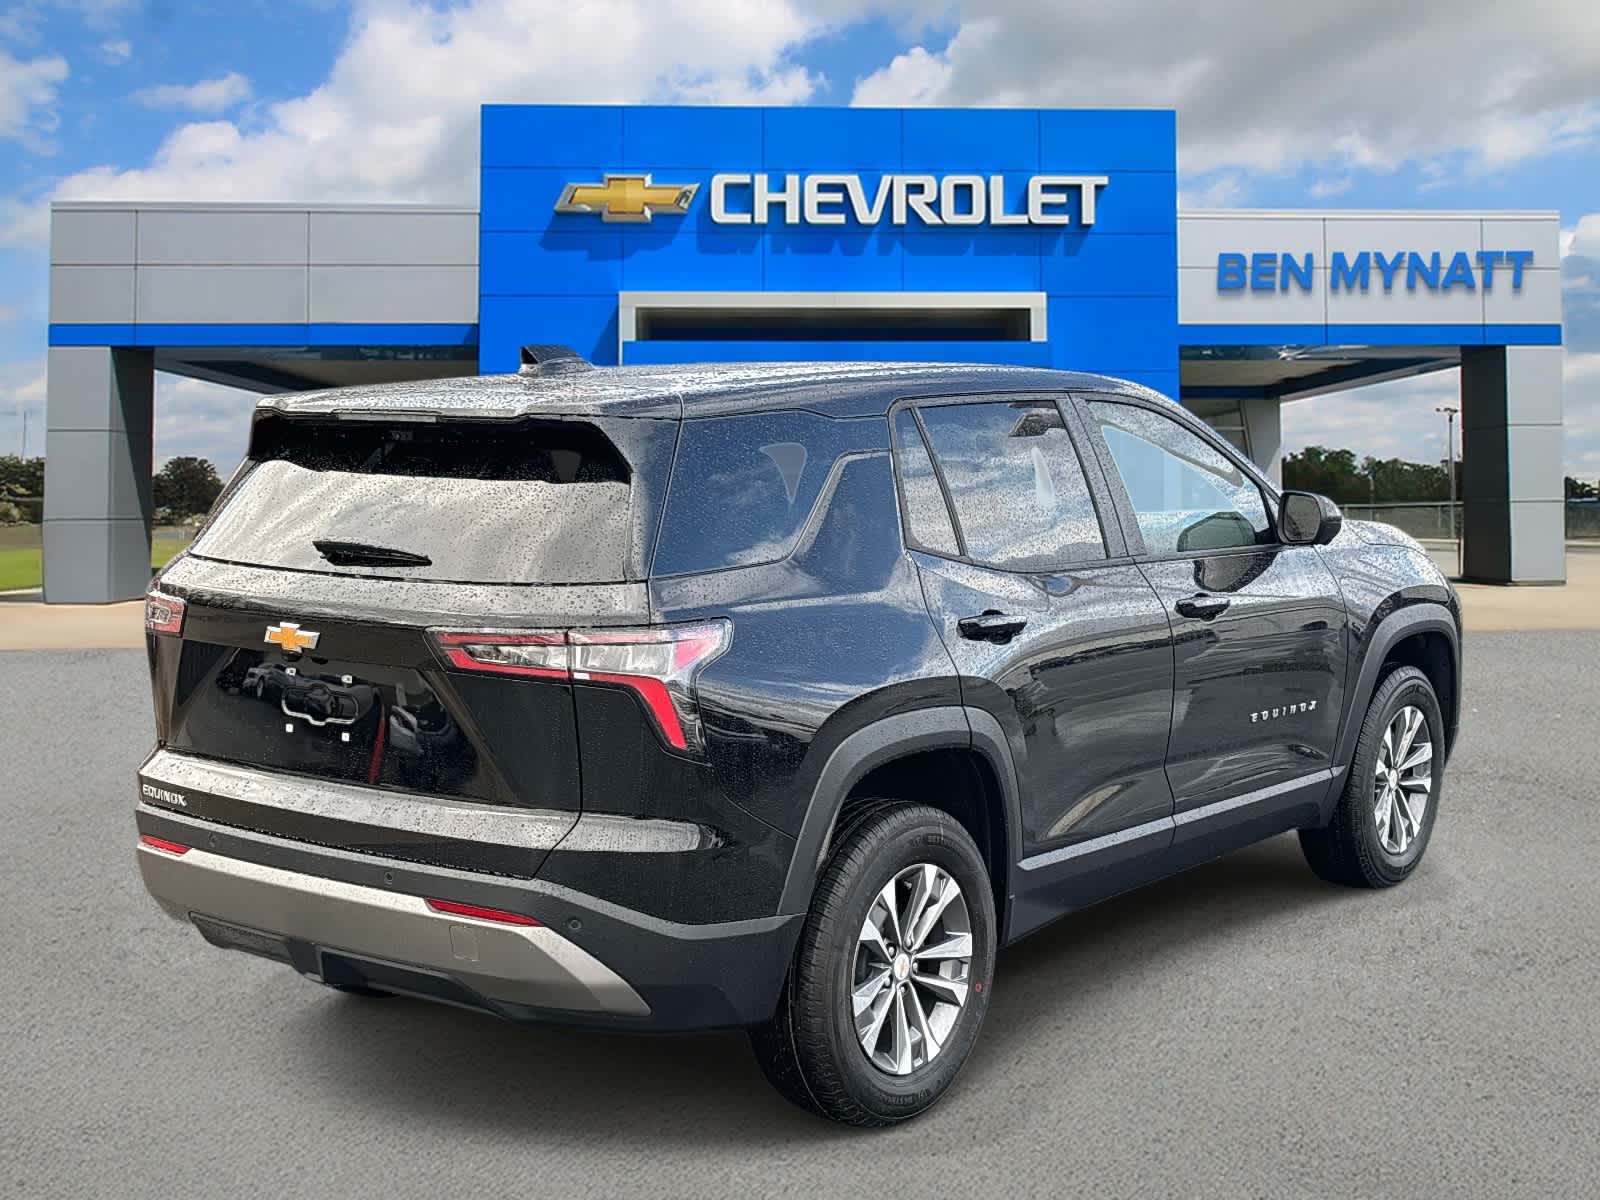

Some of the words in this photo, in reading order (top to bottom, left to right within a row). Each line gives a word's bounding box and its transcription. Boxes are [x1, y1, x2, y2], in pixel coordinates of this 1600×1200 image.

[710, 174, 1108, 225] CHEVROLET
[1217, 252, 1314, 290] BEN
[1330, 250, 1534, 289] MYNATT
[1250, 700, 1317, 722] EQUINOX
[142, 784, 187, 807] EQUINOX
